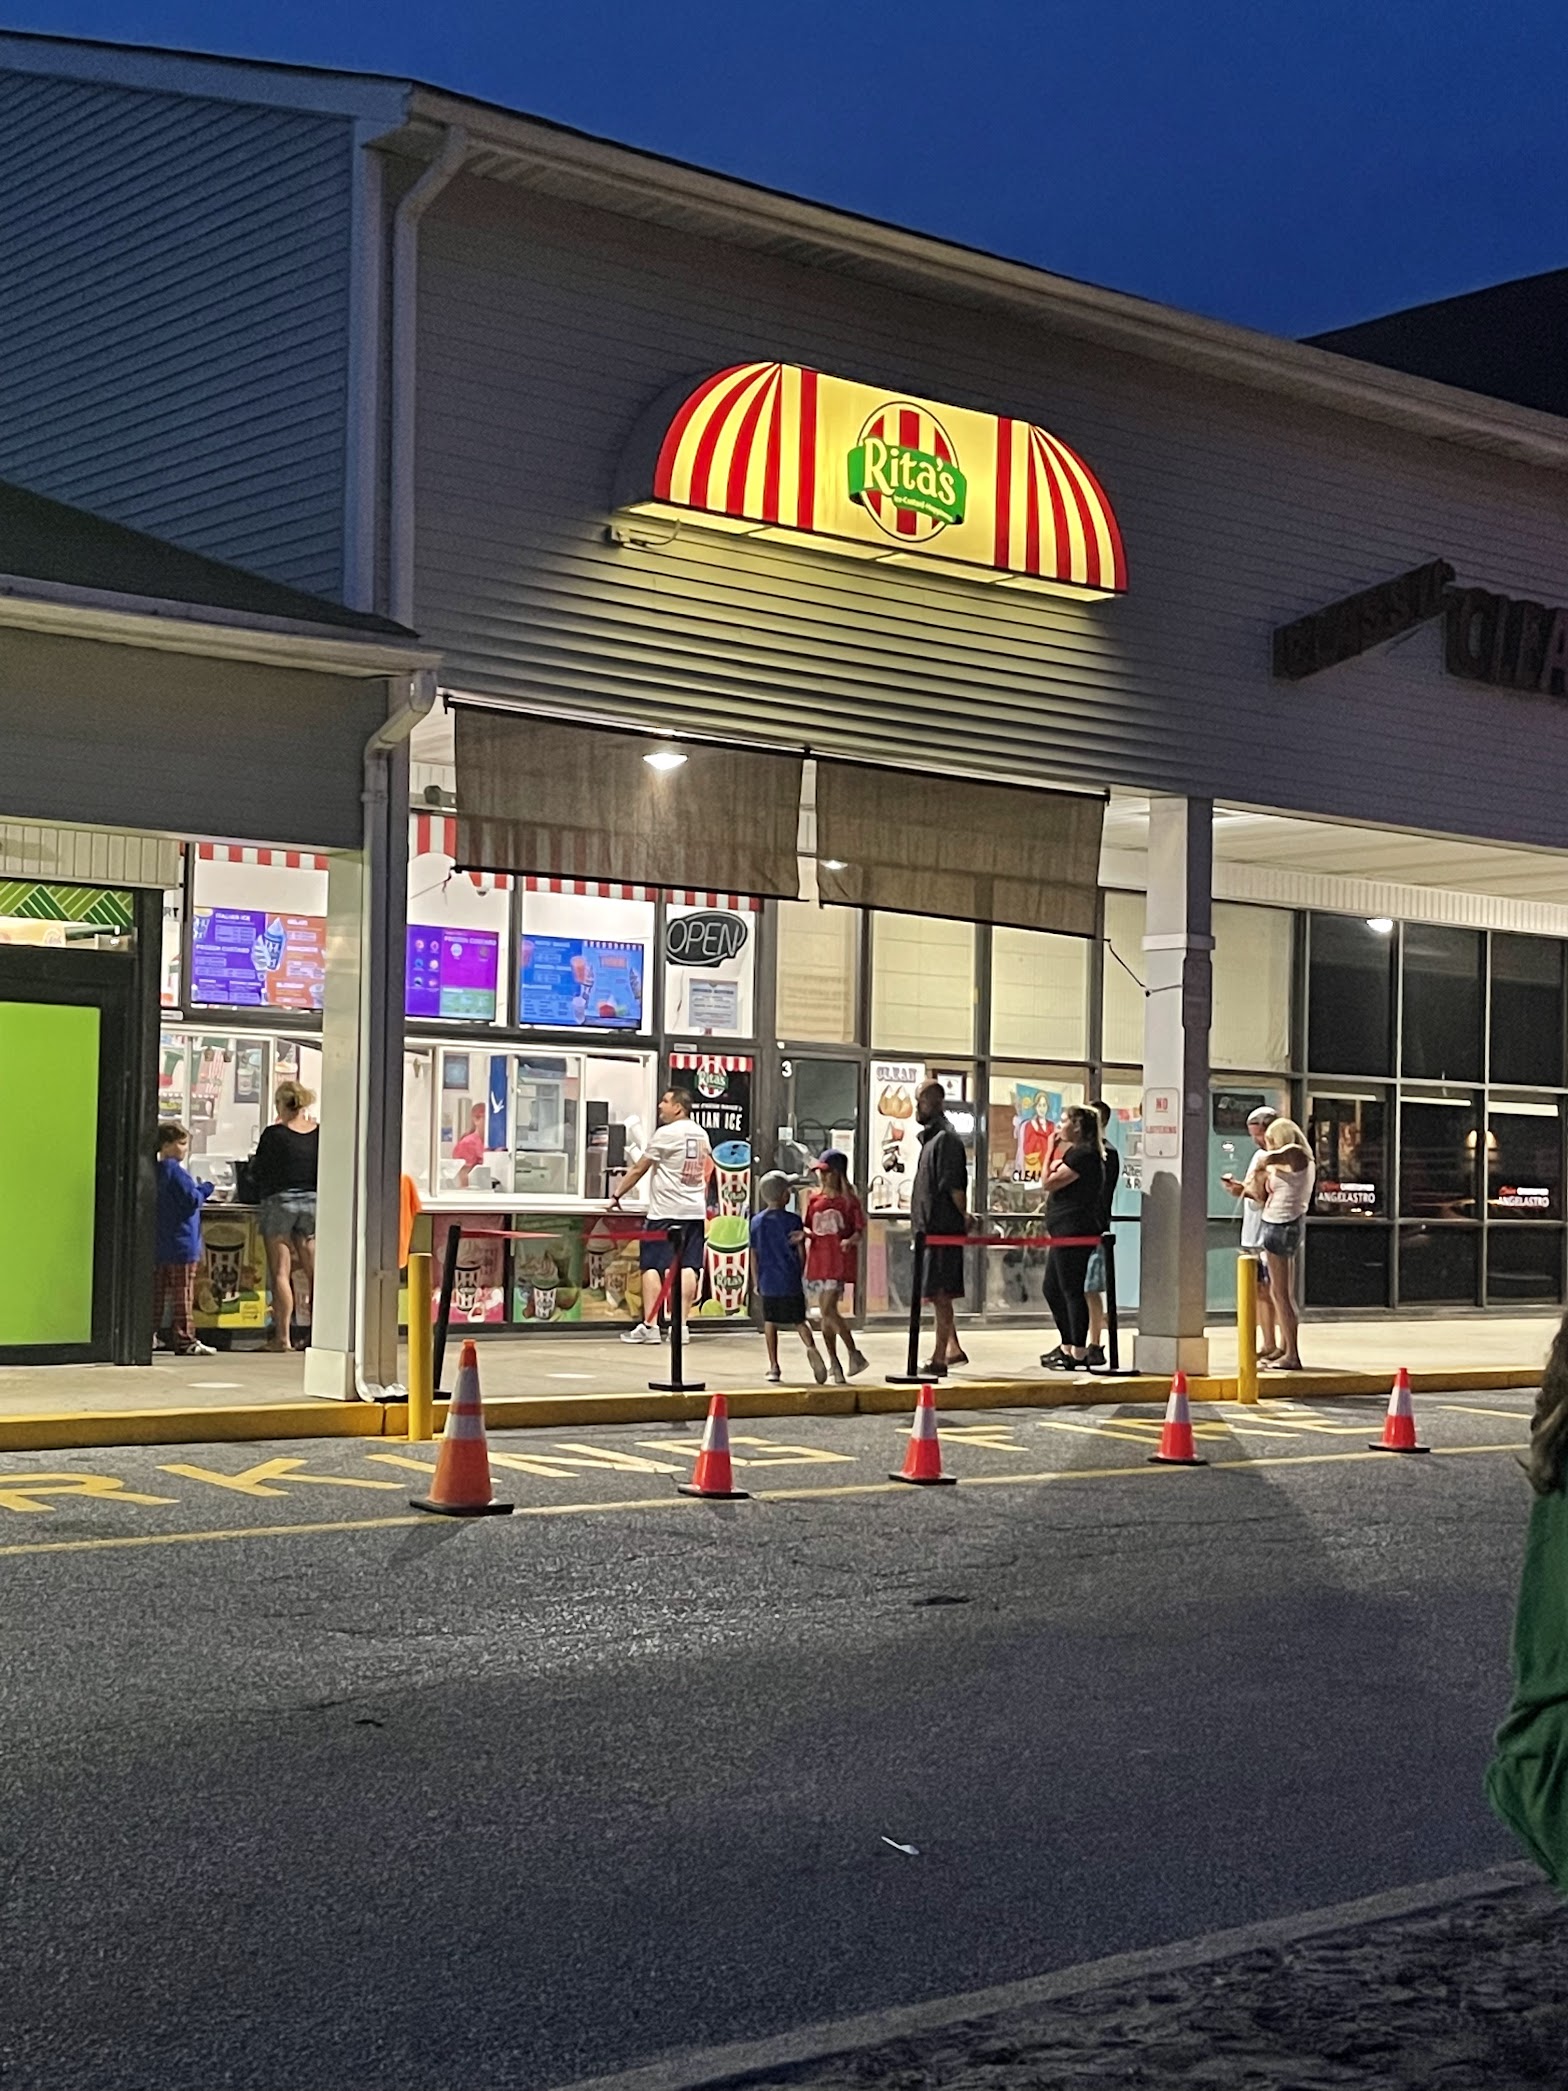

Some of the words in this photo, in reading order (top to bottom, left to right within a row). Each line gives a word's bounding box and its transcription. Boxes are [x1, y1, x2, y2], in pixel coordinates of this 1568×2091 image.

[863, 437, 956, 506] Rita's
[667, 920, 740, 957] OPEN
[781, 1060, 793, 1078] 3
[876, 1066, 918, 1084] CLEAN
[1155, 1097, 1168, 1110] NO
[724, 1112, 743, 1131] ICE
[1318, 1191, 1376, 1204] ANGELASTRO
